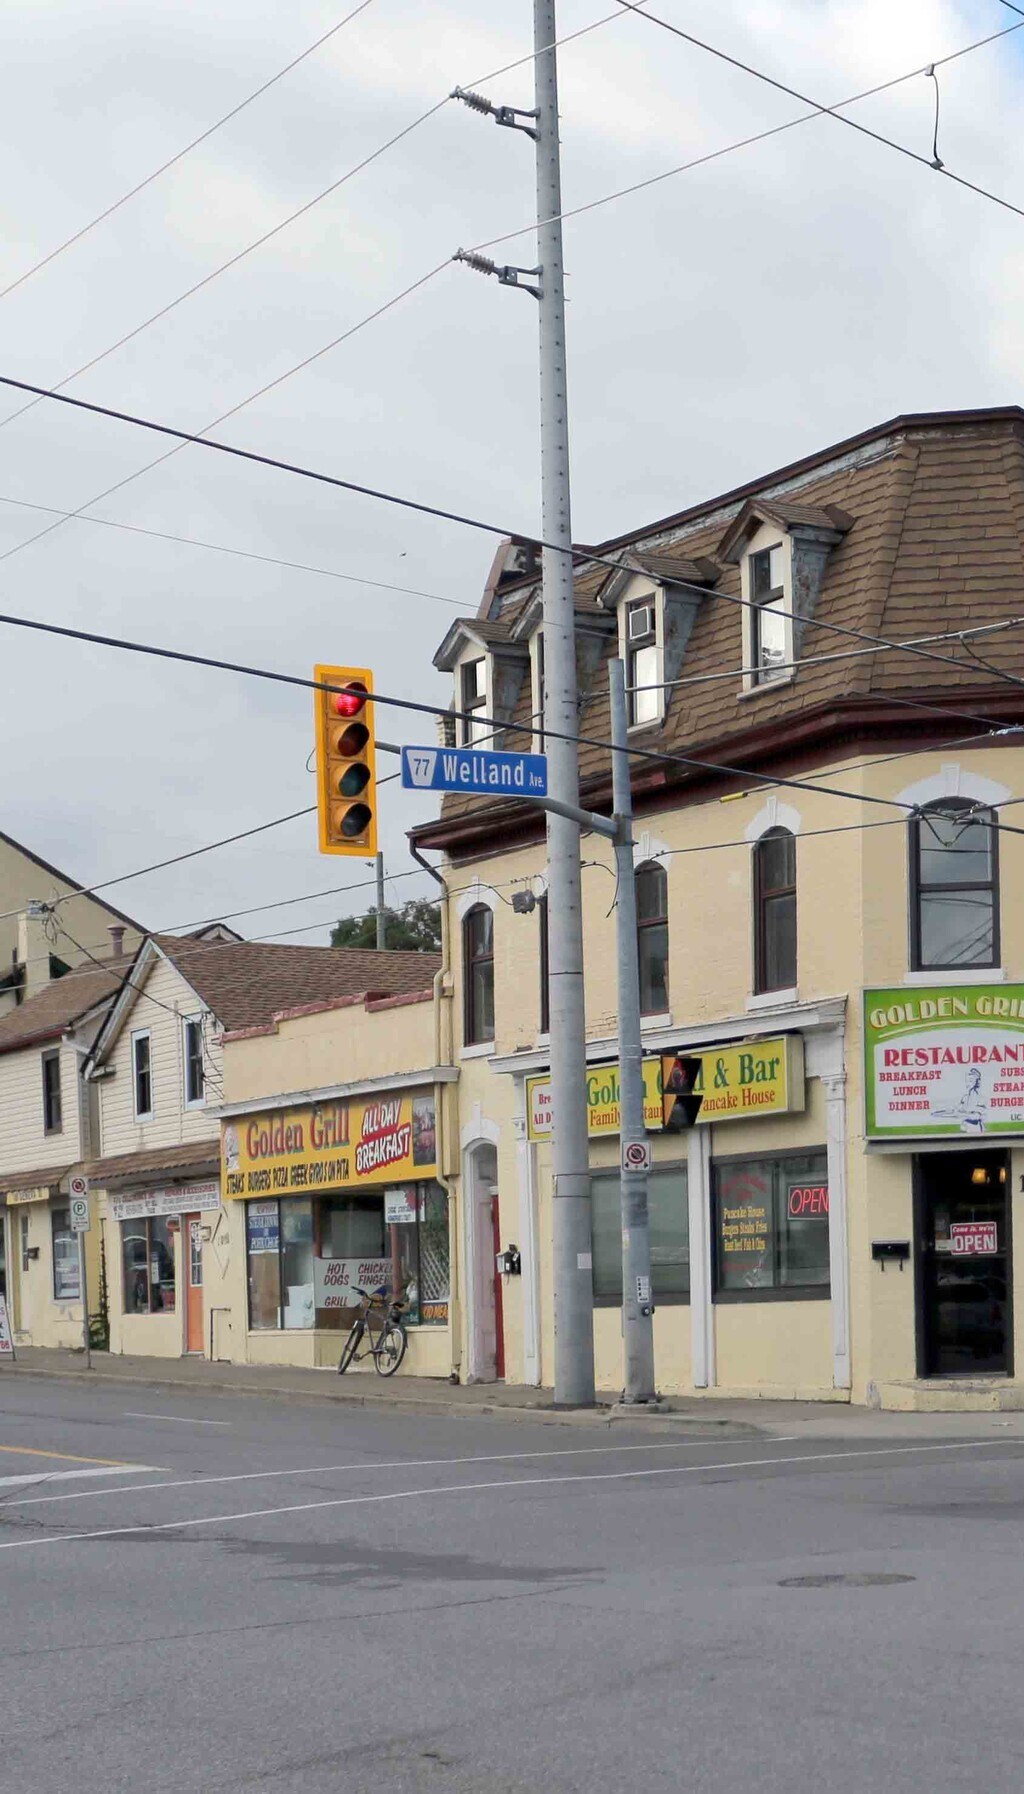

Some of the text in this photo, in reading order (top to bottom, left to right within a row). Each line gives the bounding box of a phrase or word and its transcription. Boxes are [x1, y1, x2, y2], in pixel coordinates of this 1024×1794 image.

[413, 758, 430, 777] 77
[443, 754, 524, 787] Welland
[870, 996, 968, 1028] GOLDEN
[714, 1058, 729, 1089] &
[739, 1053, 780, 1085] Bar
[879, 1070, 941, 1082] BREAKFAST
[703, 1088, 738, 1112] ancake
[742, 1087, 776, 1106] House
[893, 1086, 926, 1096] LUNCH
[362, 1098, 402, 1136] ALL DAY
[888, 1100, 930, 1111] DINNER
[246, 1101, 350, 1160] Golden Grill
[356, 1127, 410, 1171] BREAKFAST
[226, 1172, 245, 1194] STEAKS
[248, 1169, 271, 1192] BURGERS
[273, 1165, 288, 1188] PIZZA
[291, 1163, 308, 1186] GREEK
[337, 1158, 349, 1180] PITA
[789, 1187, 829, 1214] OPEN
[954, 1234, 995, 1252] OPEN
[324, 1275, 349, 1286] DOGS
[327, 1263, 392, 1274] HOT CHICKE
[325, 1296, 348, 1307] GRILL
